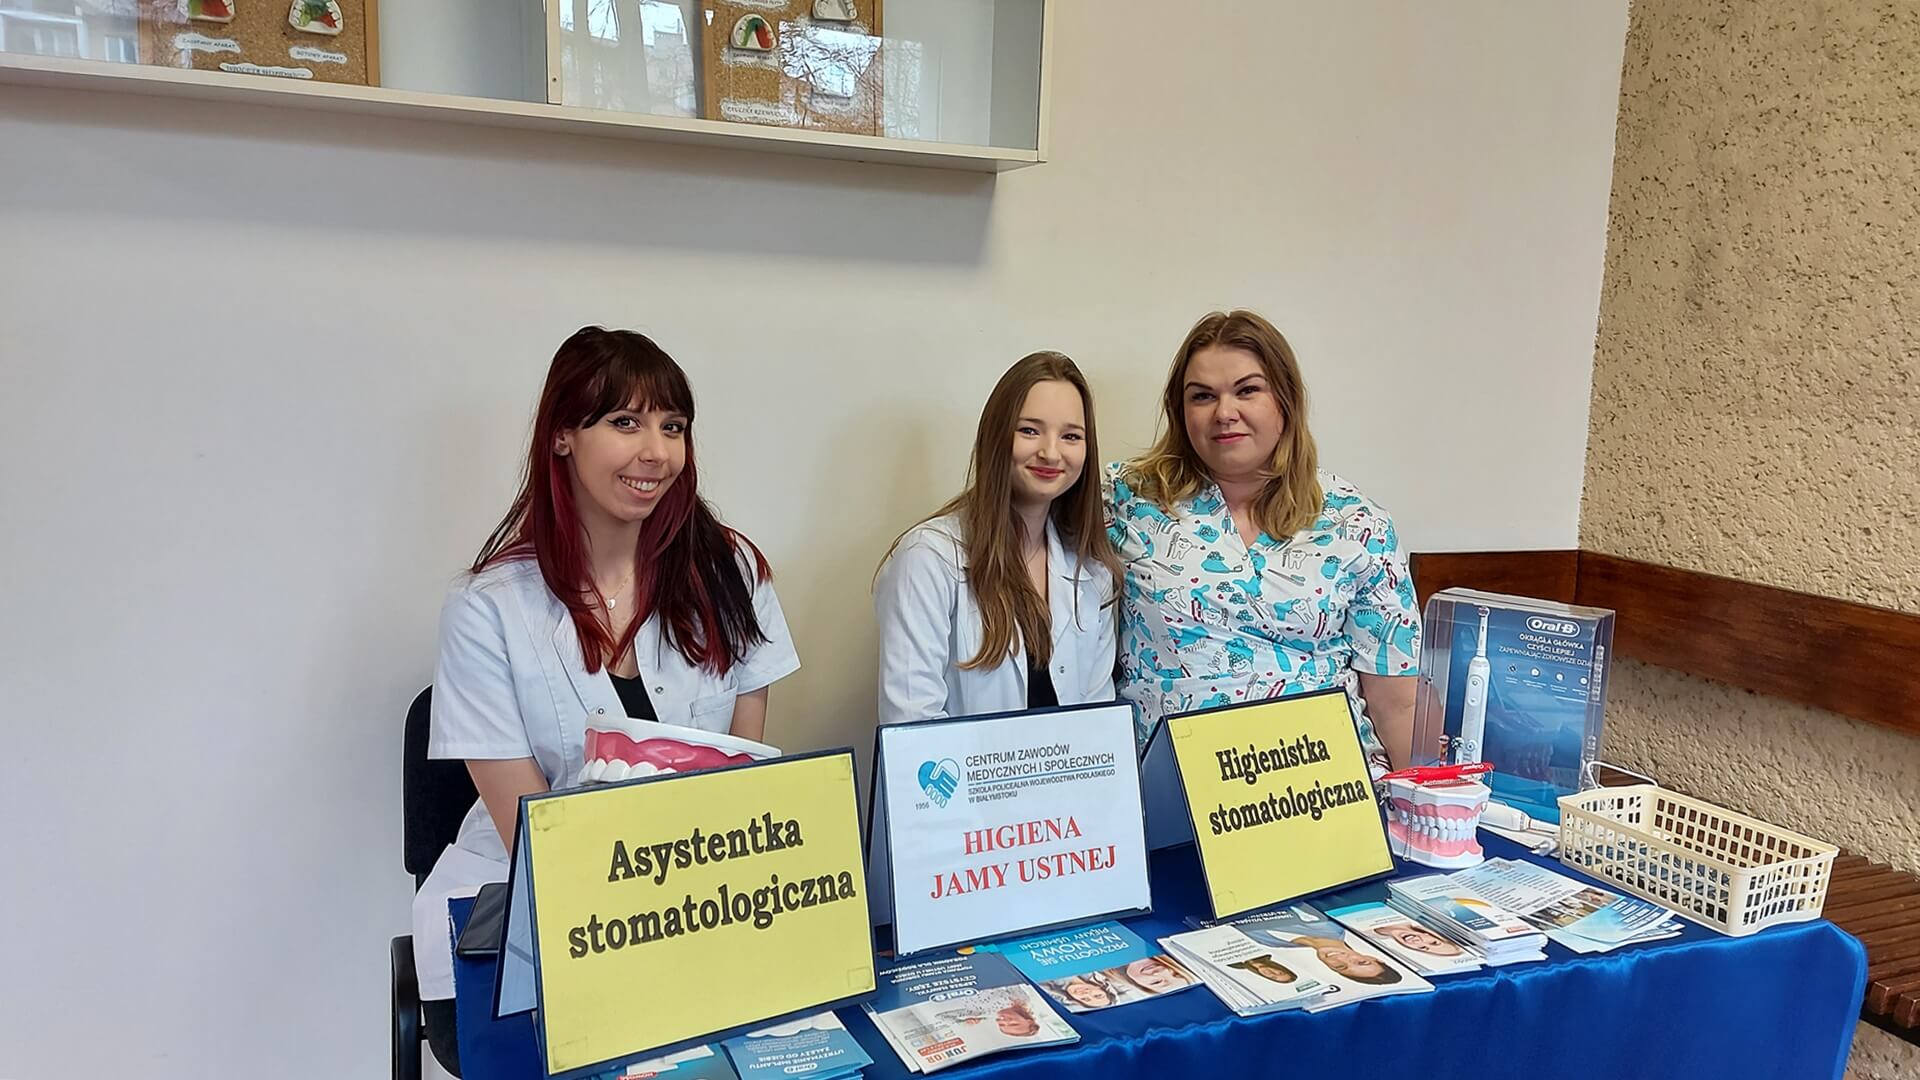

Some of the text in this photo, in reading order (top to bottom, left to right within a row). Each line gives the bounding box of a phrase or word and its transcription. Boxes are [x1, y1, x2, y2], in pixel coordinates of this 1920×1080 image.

[1531, 619, 1576, 634] Oral-B
[1519, 633, 1584, 650] OKRĄGŁA GŁÓWKA
[1527, 643, 1575, 656] CZYŚCI LEPIEJ
[1542, 653, 1576, 664] ZDROWSZE
[965, 743, 1070, 767] CENTRUM ZAWODÓW
[1215, 733, 1331, 785] Higienistka
[966, 762, 1037, 782] MEDYCZNYCH
[1044, 752, 1115, 771] SPOŁECZNYCH
[992, 780, 1029, 793] POLICEALNA
[1029, 774, 1075, 789] WOJEWÓDZTWA
[1075, 768, 1116, 781] PODLASKIEGO
[968, 790, 1018, 804] W BIAŁYMSTOKU
[1209, 779, 1369, 835] stomatologiczna
[963, 816, 1082, 855] HIGIENA
[607, 812, 803, 885] Asystentka
[930, 845, 1116, 899] JAMY USTNEJ
[568, 870, 856, 959] stomatologiczna
[1073, 926, 1109, 940] PIĘKNY
[1030, 932, 1122, 960] NA NOWY
[1059, 941, 1129, 962] PRZYGOTUJ
[932, 975, 977, 986] CZYSTSZE
[749, 1048, 845, 1070] UTRZYMANIE IMPLANTU
[926, 1045, 967, 1064] JUNIOR
